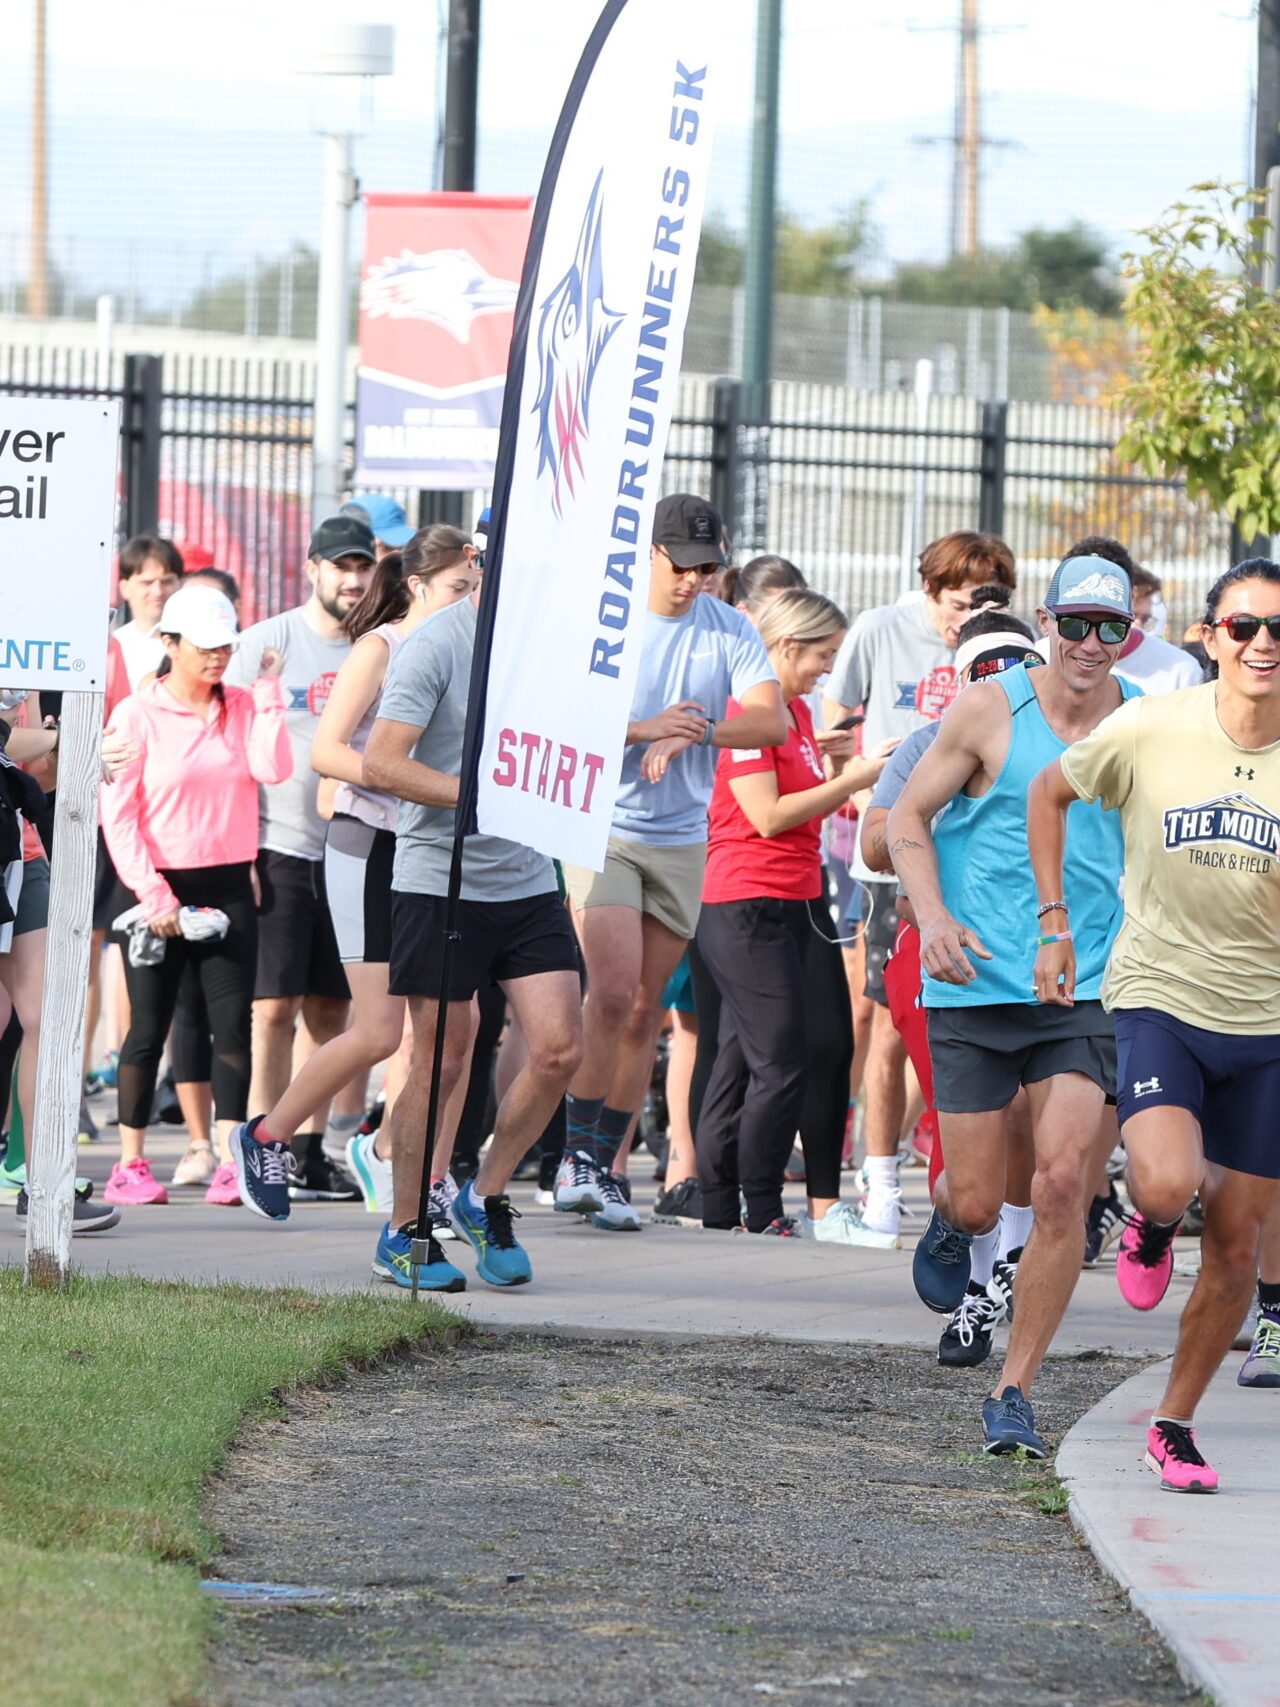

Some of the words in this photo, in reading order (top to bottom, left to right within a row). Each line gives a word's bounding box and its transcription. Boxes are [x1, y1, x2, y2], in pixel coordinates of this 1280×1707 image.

[588, 165, 691, 680] ROADRUNNERS
[668, 58, 708, 146] 5K
[492, 727, 606, 814] START
[1167, 809, 1216, 845] THE
[1188, 848, 1227, 869] TRACK
[1228, 853, 1238, 871] &
[1239, 855, 1271, 874] FIELD
